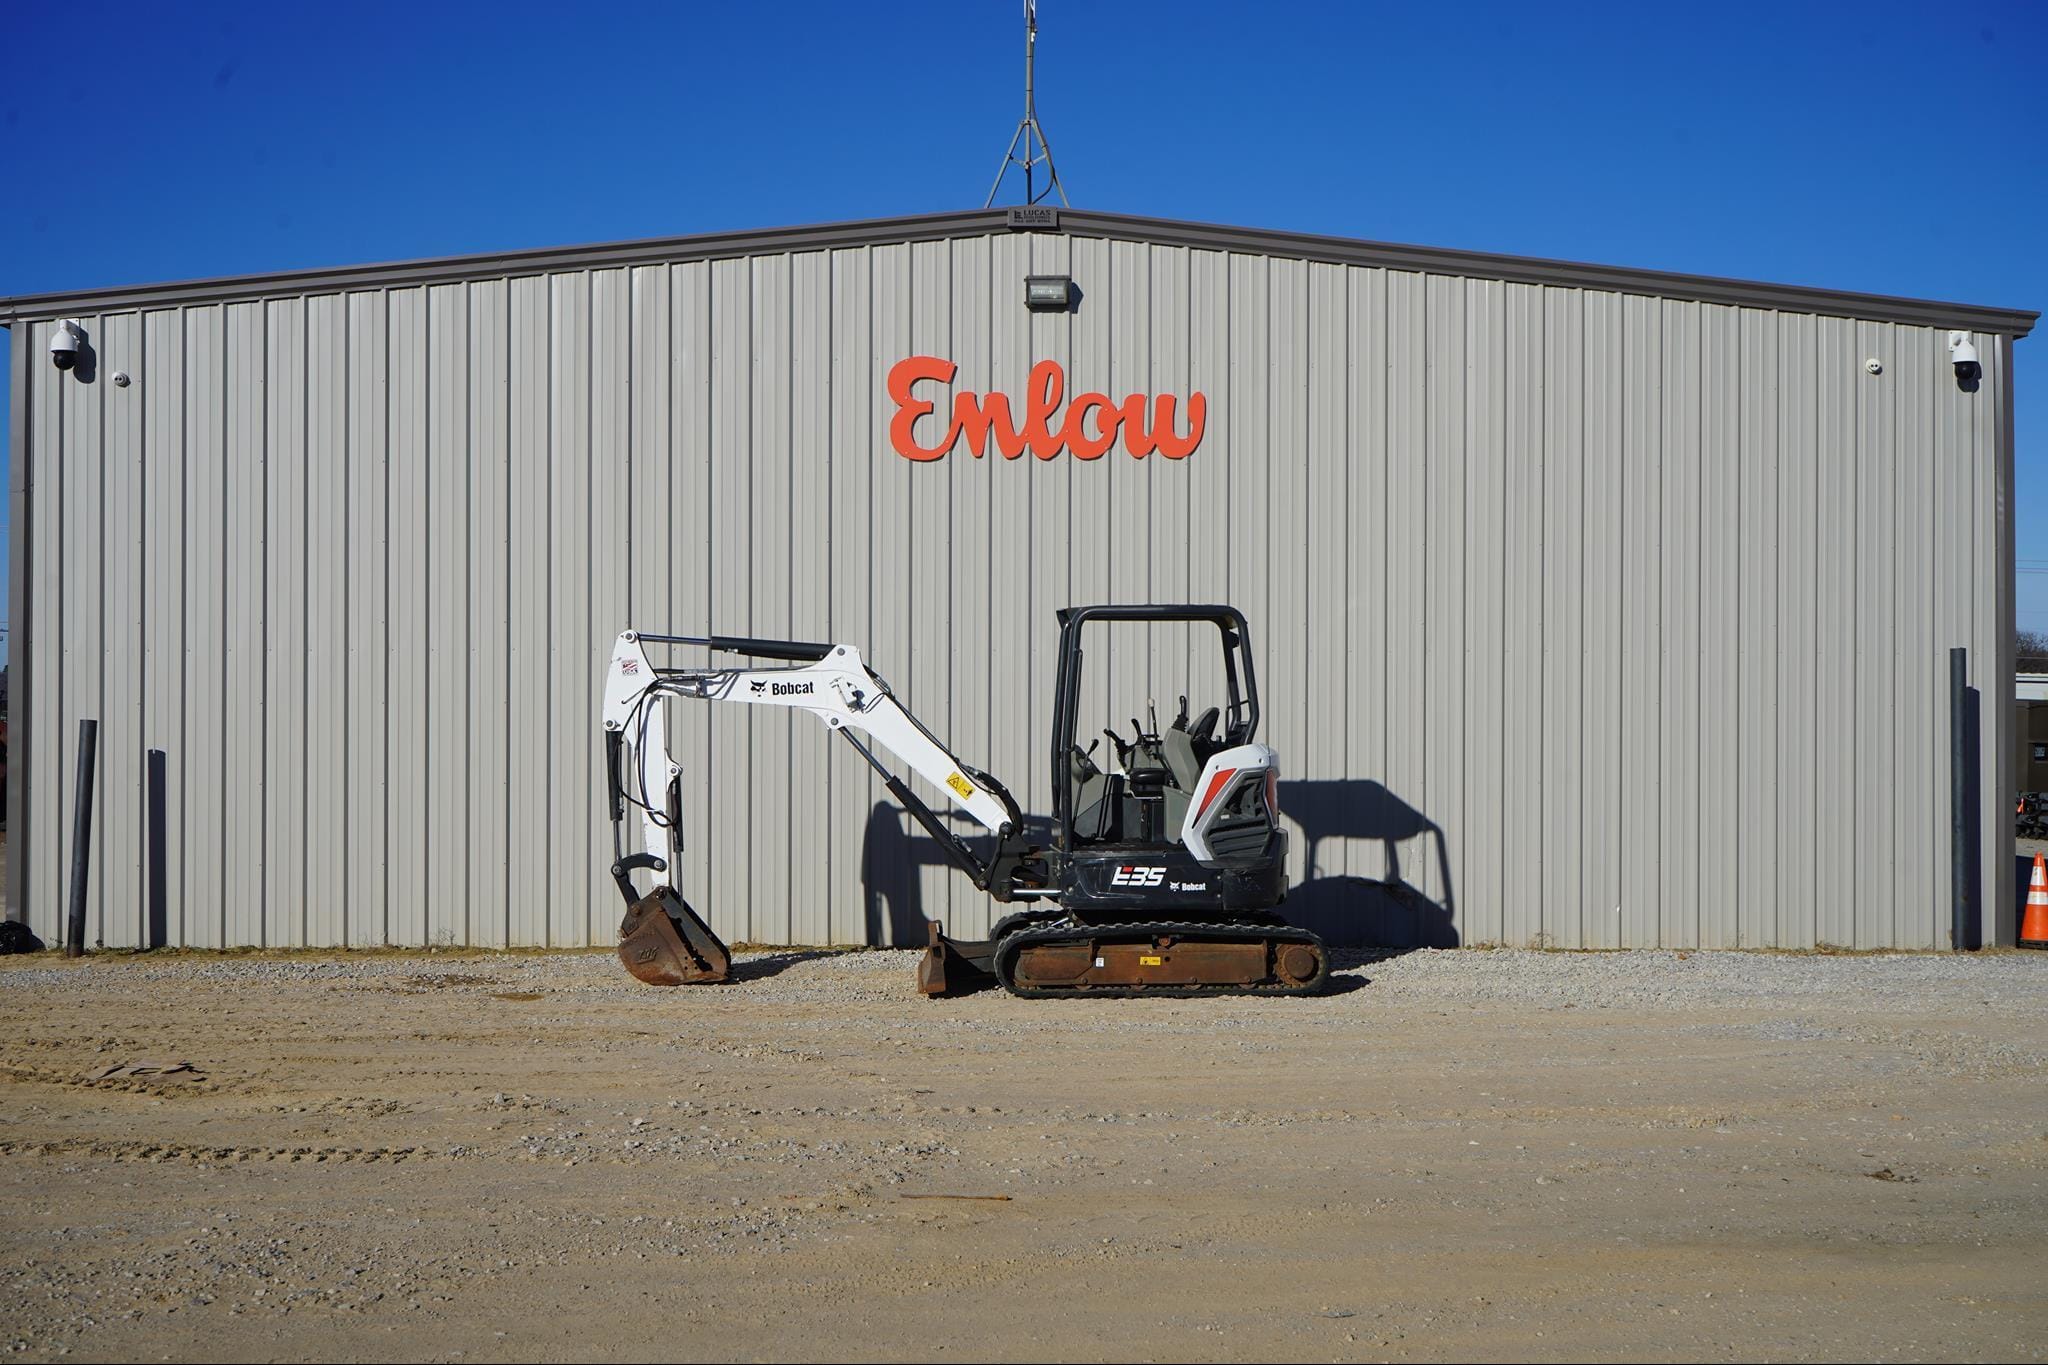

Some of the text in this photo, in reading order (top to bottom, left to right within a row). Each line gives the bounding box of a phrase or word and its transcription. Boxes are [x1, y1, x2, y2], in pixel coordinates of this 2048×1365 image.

[887, 356, 1206, 461] Enlow
[772, 681, 814, 696] Bobcat
[1111, 866, 1167, 886] E35
[1181, 883, 1206, 891] Bobcat
